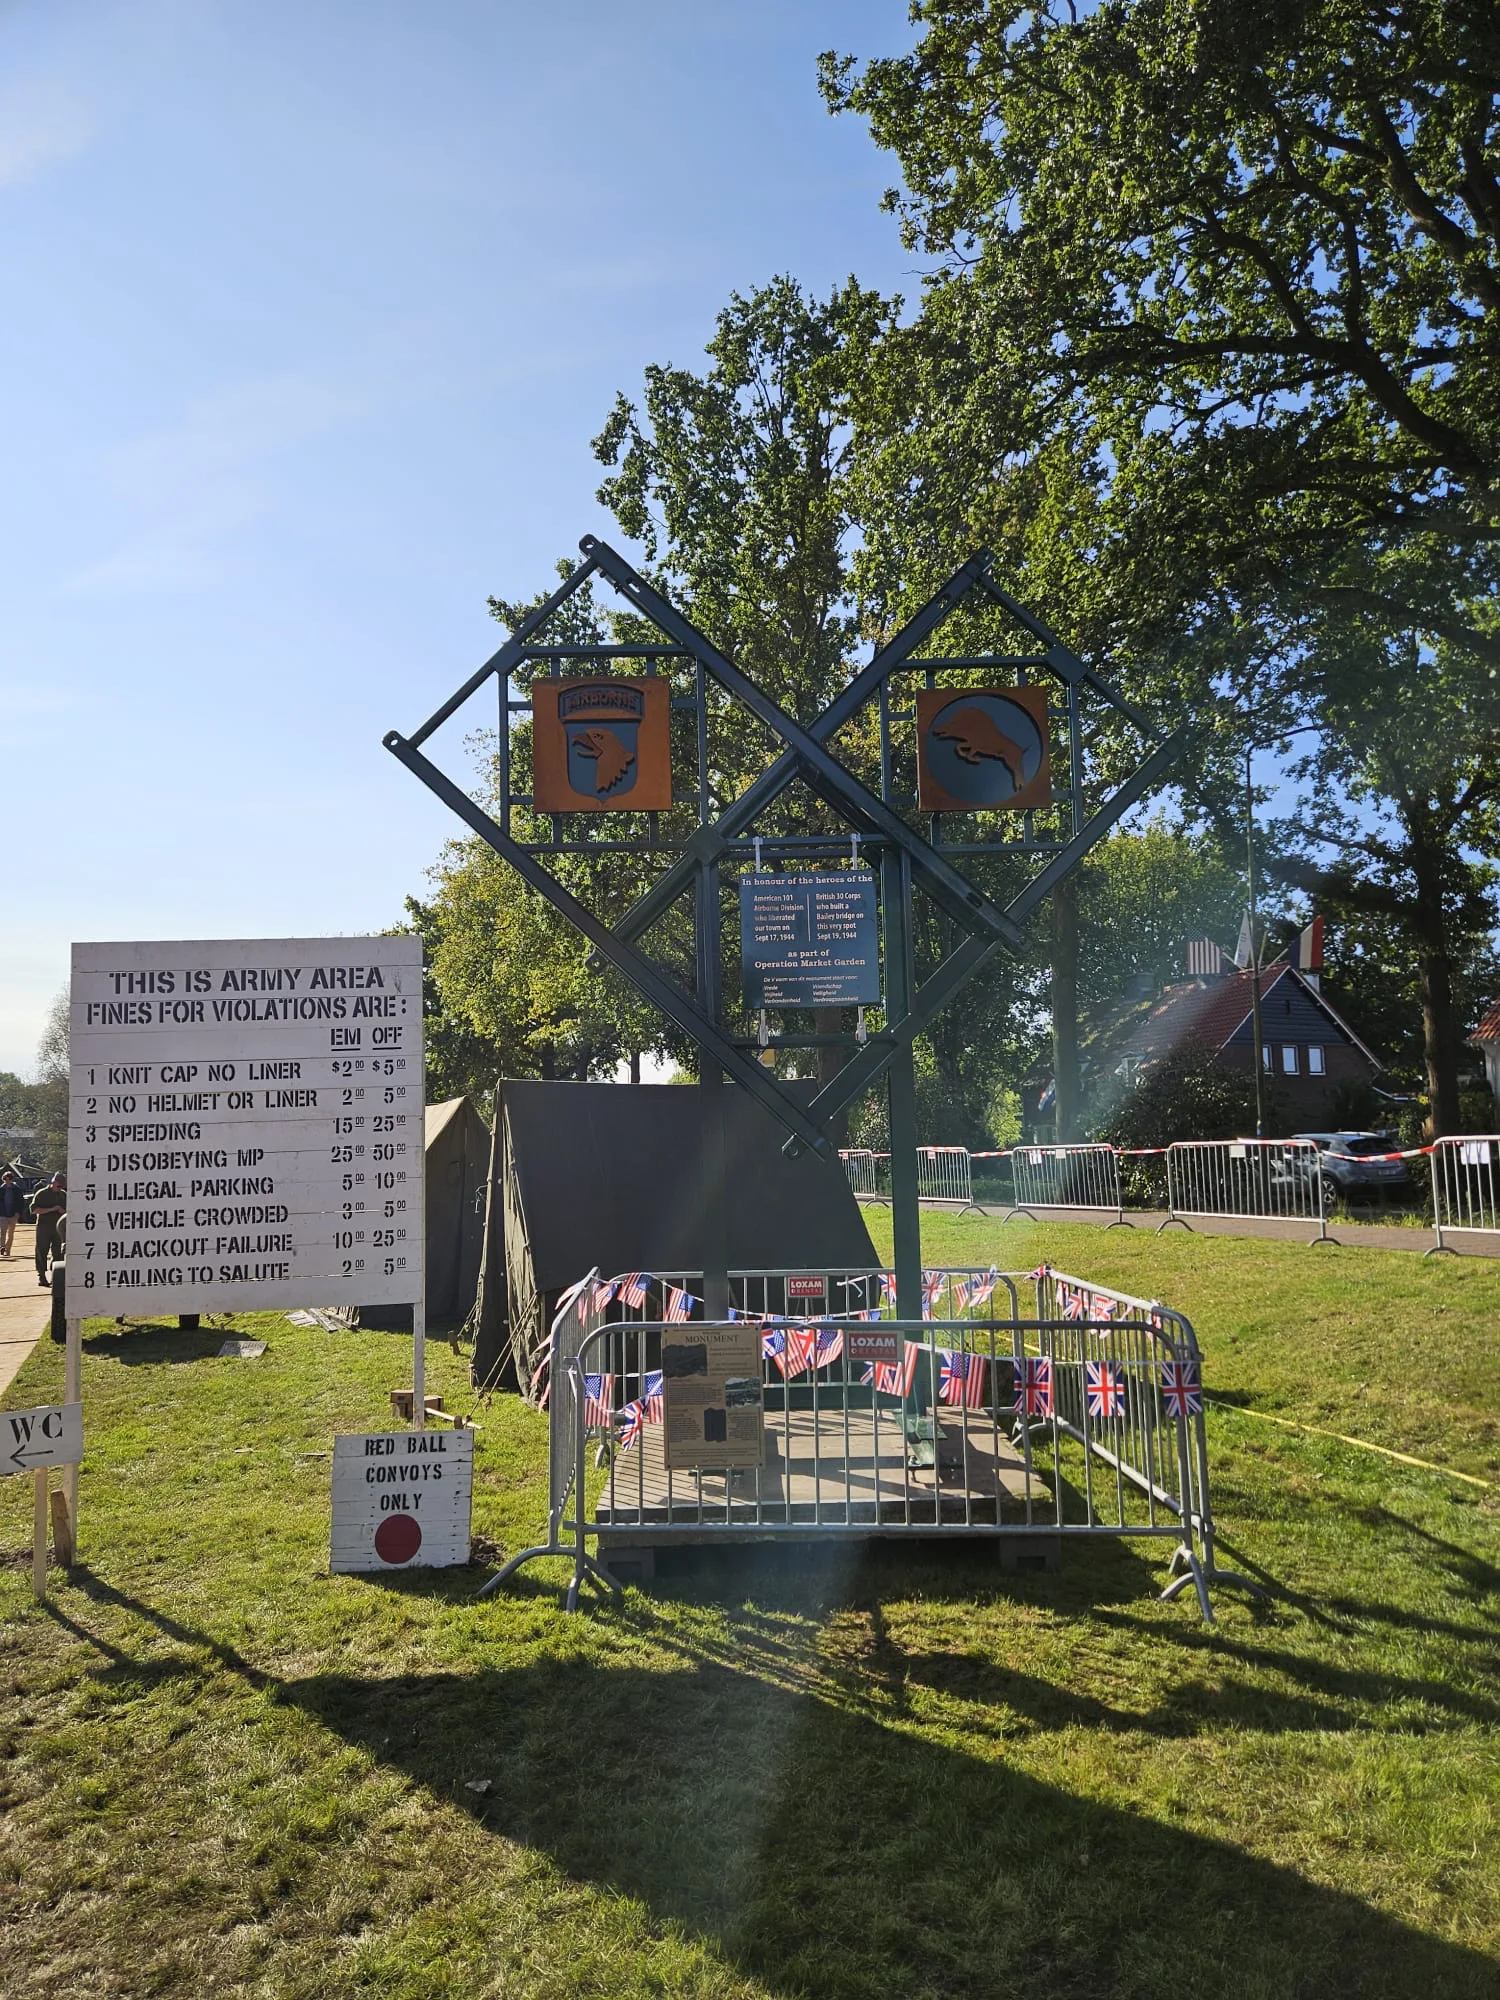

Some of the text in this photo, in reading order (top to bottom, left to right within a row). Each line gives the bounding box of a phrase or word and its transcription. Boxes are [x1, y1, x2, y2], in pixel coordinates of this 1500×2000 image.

[742, 878, 752, 886] In
[754, 878, 785, 886] honour
[787, 877, 797, 885] of
[798, 877, 814, 885] the
[816, 876, 845, 884] heroes
[847, 875, 856, 883] of
[836, 892, 844, 900] 30
[845, 892, 861, 900] Corps
[816, 913, 835, 921] Bailey
[836, 912, 855, 920] bridge
[770, 934, 779, 942] 17,
[817, 933, 831, 941] Sept
[755, 958, 865, 970] Operation Market Garden
[800, 950, 818, 959] part
[109, 967, 384, 994] THIS IS ARMY AREA
[87, 1002, 152, 1025] FINES
[159, 1000, 205, 1024] FOR
[212, 997, 347, 1022] VIOLATIONS
[331, 1026, 403, 1045] EM OFF
[88, 1069, 95, 1085] 1
[108, 1066, 152, 1085] KNIT
[160, 1065, 198, 1083] CAP
[208, 1064, 236, 1082] NO
[249, 1062, 302, 1081] LINER
[86, 1097, 97, 1114] 2
[109, 1096, 136, 1113] NO
[148, 1093, 220, 1112] HELMET
[228, 1092, 254, 1110] OR
[265, 1090, 318, 1109] LINER
[85, 1125, 97, 1143] 3
[108, 1122, 201, 1143] SPEEDING
[85, 1155, 96, 1172] 4
[107, 1149, 228, 1172] DISOBEYING
[237, 1148, 264, 1167] MP
[85, 1184, 96, 1201] 5
[108, 1181, 182, 1201] ILLEGAL
[191, 1176, 274, 1198] PARKING
[85, 1213, 96, 1231] 6
[107, 1209, 185, 1230] VEHICLE
[194, 1205, 289, 1227] CROWDED
[85, 1242, 95, 1260] 7
[107, 1237, 209, 1260] BLACKOUT
[216, 1234, 293, 1255] FAILURE
[84, 1271, 95, 1289] 8
[106, 1267, 183, 1288] FAILING
[188, 1266, 213, 1285] TO
[219, 1262, 290, 1283] SALUTE
[791, 1281, 822, 1289] LOXAM
[685, 1335, 740, 1344] MONUMENT
[850, 1337, 896, 1347] LOXAM
[8, 1412, 63, 1445] WC
[365, 1435, 447, 1456] RED BALL
[366, 1463, 442, 1483] CONVOYS
[380, 1493, 422, 1511] ONLY
